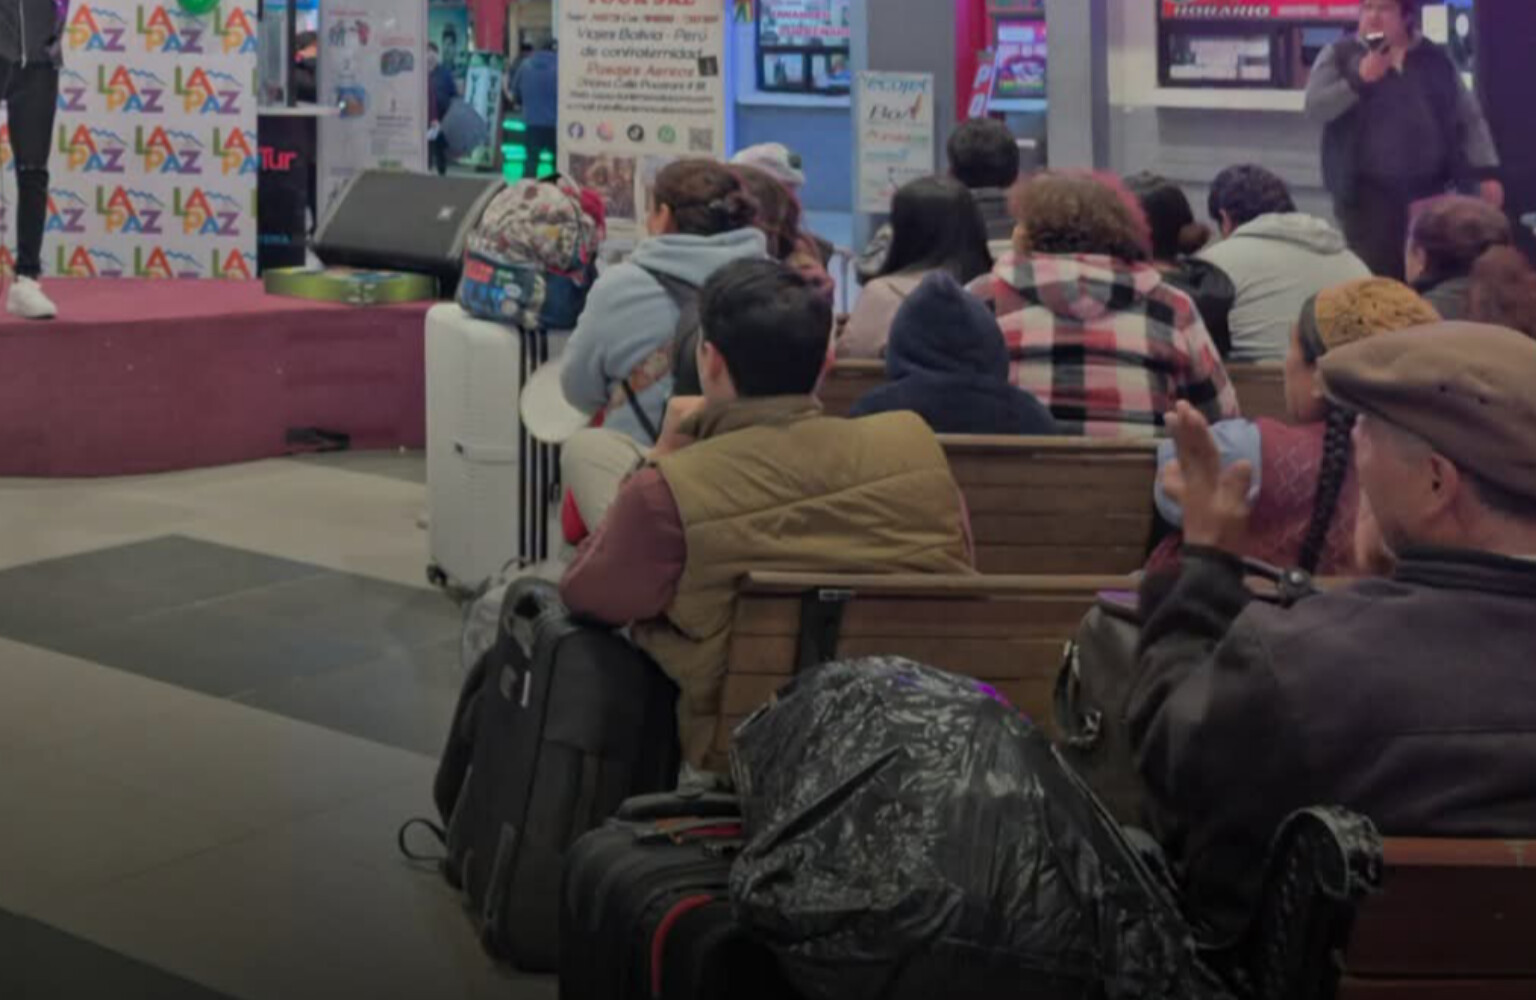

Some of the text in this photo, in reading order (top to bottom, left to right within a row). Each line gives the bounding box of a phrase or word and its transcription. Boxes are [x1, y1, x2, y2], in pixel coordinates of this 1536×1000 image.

[136, 5, 175, 34] LA
[214, 6, 253, 36] LA
[1173, 4, 1271, 18] HORARIO
[68, 27, 126, 53] PAZ
[145, 27, 204, 54] PAZ
[98, 65, 137, 96] LA
[174, 66, 215, 97] LA
[107, 87, 164, 114] PAZ
[183, 89, 241, 116] PAZ
[58, 123, 97, 154] LA
[135, 125, 175, 155] LA
[213, 126, 253, 158] LA
[68, 147, 125, 174] PAZ
[144, 149, 202, 175] PAZ
[96, 185, 135, 216] LA
[173, 187, 212, 218] LA
[106, 209, 163, 235] PAZ
[183, 210, 241, 237] PAZ
[57, 245, 96, 277] LA
[135, 245, 174, 278] LA
[213, 247, 252, 279] LA
